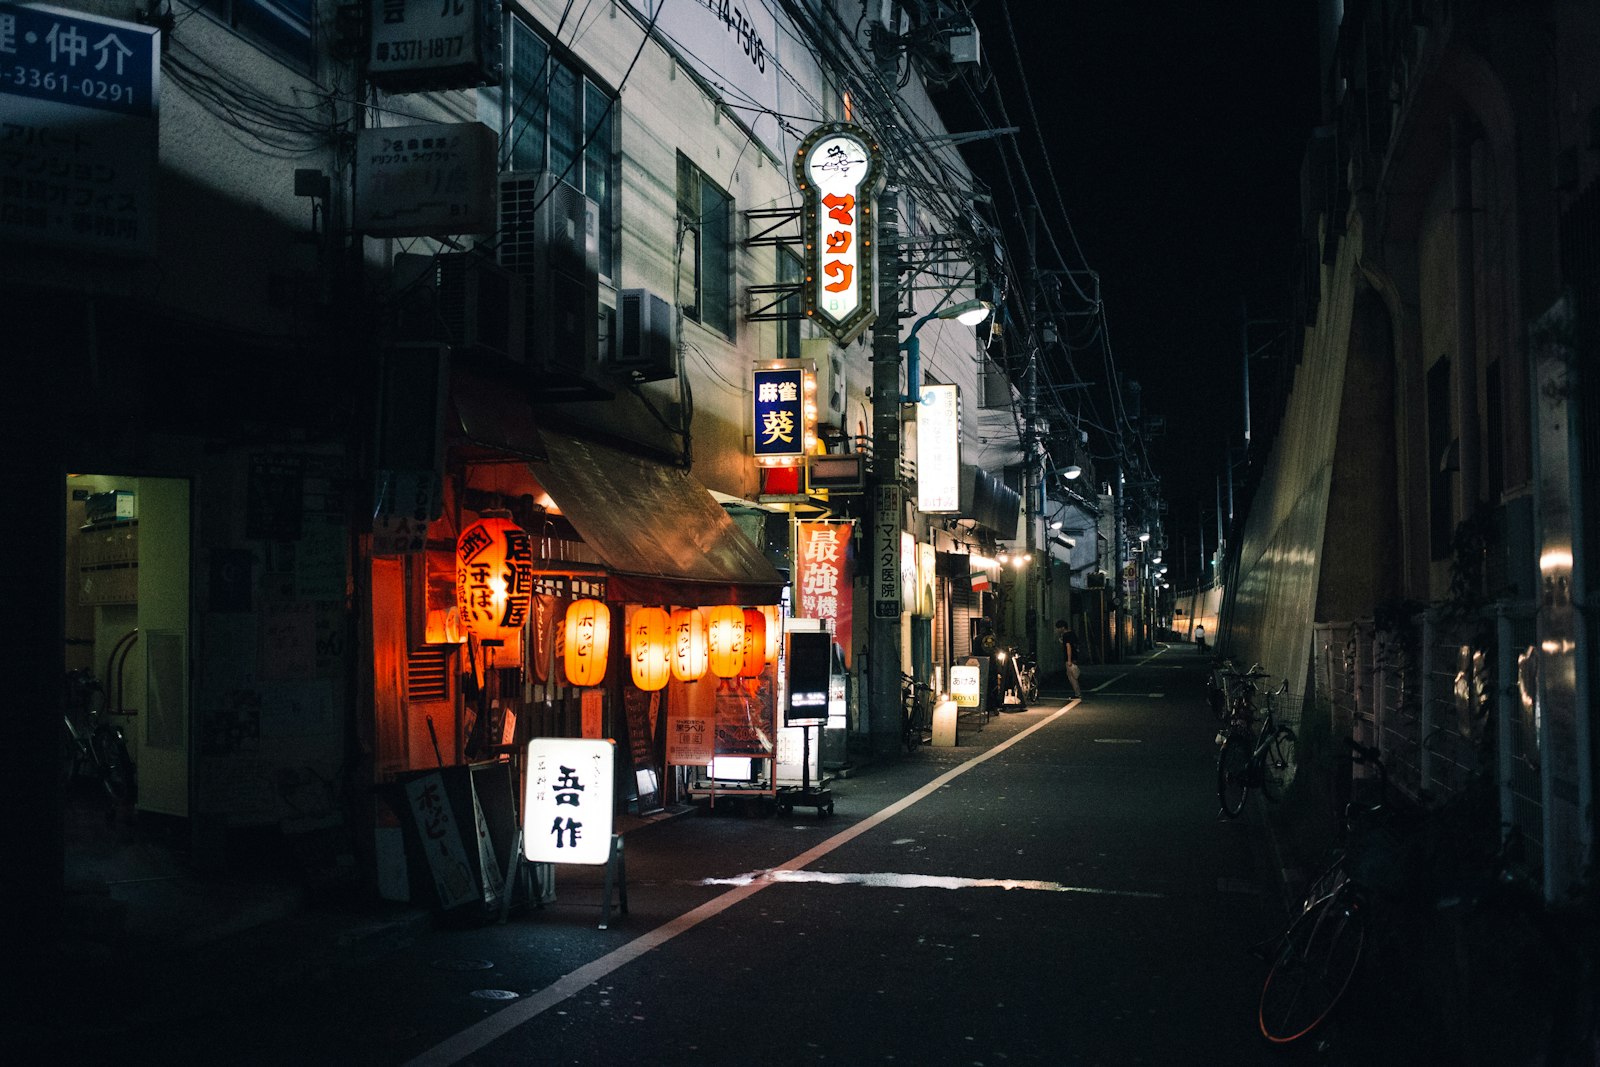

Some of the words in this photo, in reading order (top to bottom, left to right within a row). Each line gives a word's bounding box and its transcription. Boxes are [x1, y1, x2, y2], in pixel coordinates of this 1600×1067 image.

[0, 66, 134, 105] -3361-0291
[821, 192, 855, 293] マック
[758, 381, 798, 404] 麻雀
[761, 410, 795, 445] 葵
[500, 529, 532, 628] 居酒屋
[880, 523, 896, 599] マスタ医院
[578, 615, 594, 674] ホッピー
[636, 625, 648, 677] ホッピー
[677, 622, 691, 671] ホッピー
[952, 677, 977, 686] あけみ
[676, 723, 706, 733] 黒ラベル
[415, 783, 449, 857] ホッピー
[550, 764, 585, 849] 吾作
